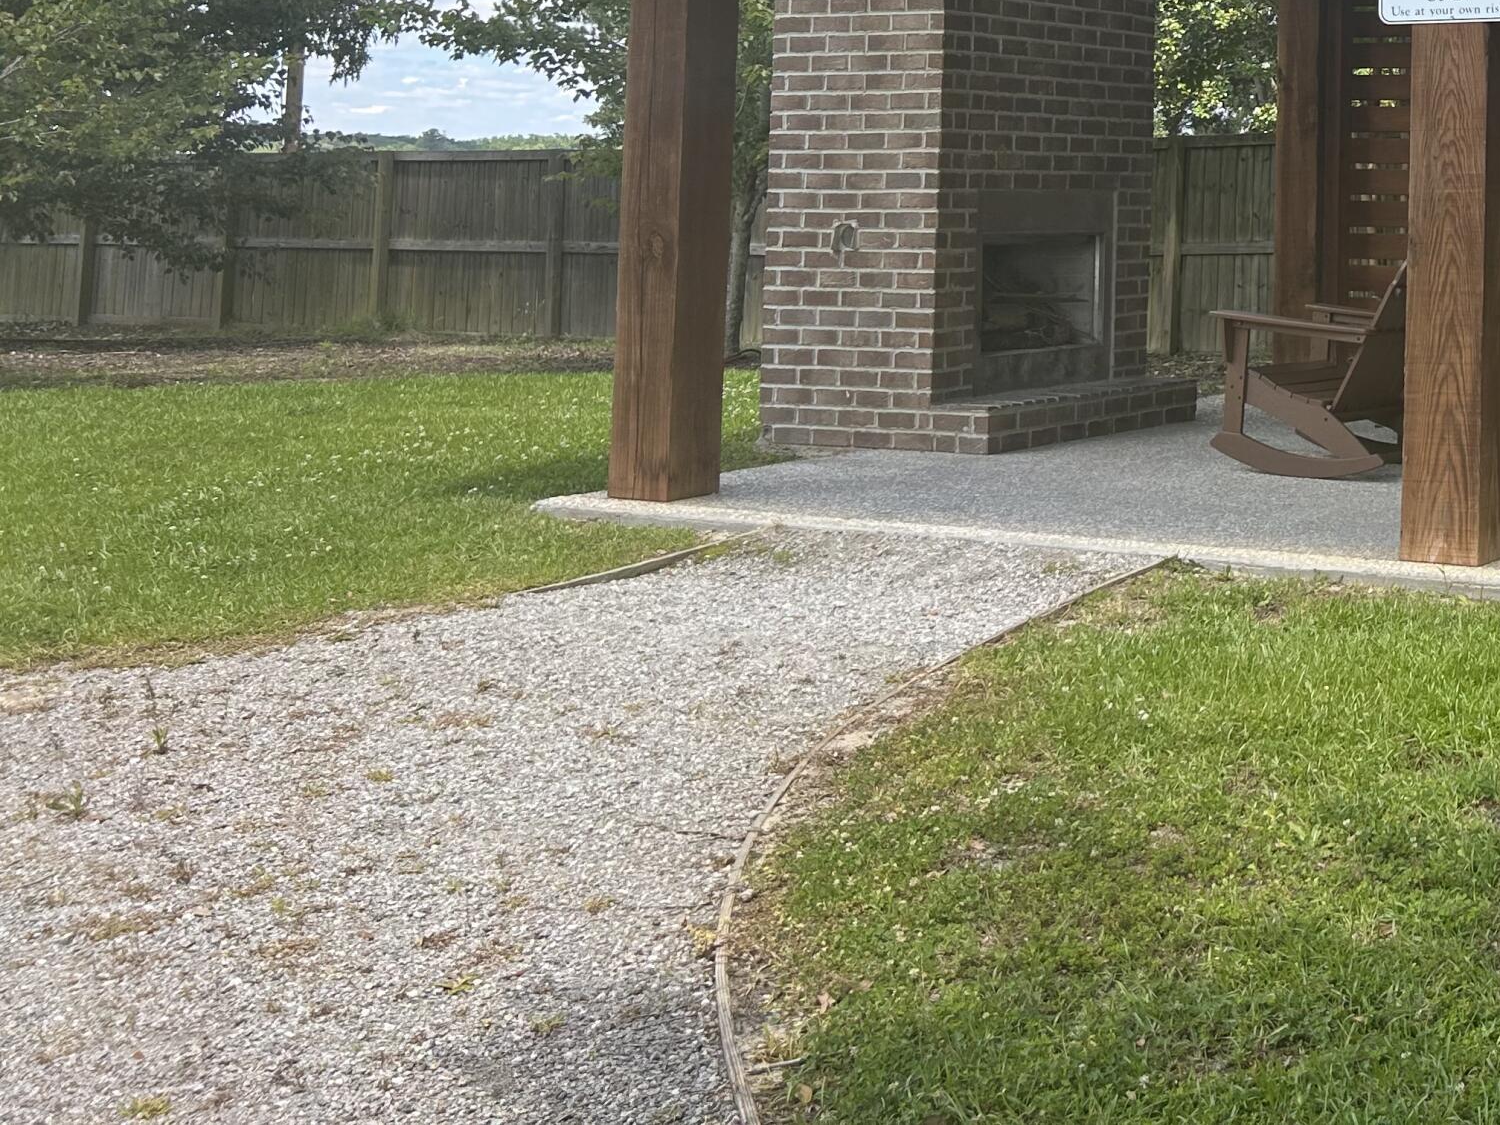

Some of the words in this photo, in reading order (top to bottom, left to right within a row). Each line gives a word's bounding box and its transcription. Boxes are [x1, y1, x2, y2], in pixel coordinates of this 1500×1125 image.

[1391, 6, 1410, 16] Use
[1415, 8, 1424, 16] at
[1430, 7, 1453, 16] your
[1459, 6, 1480, 14] own
